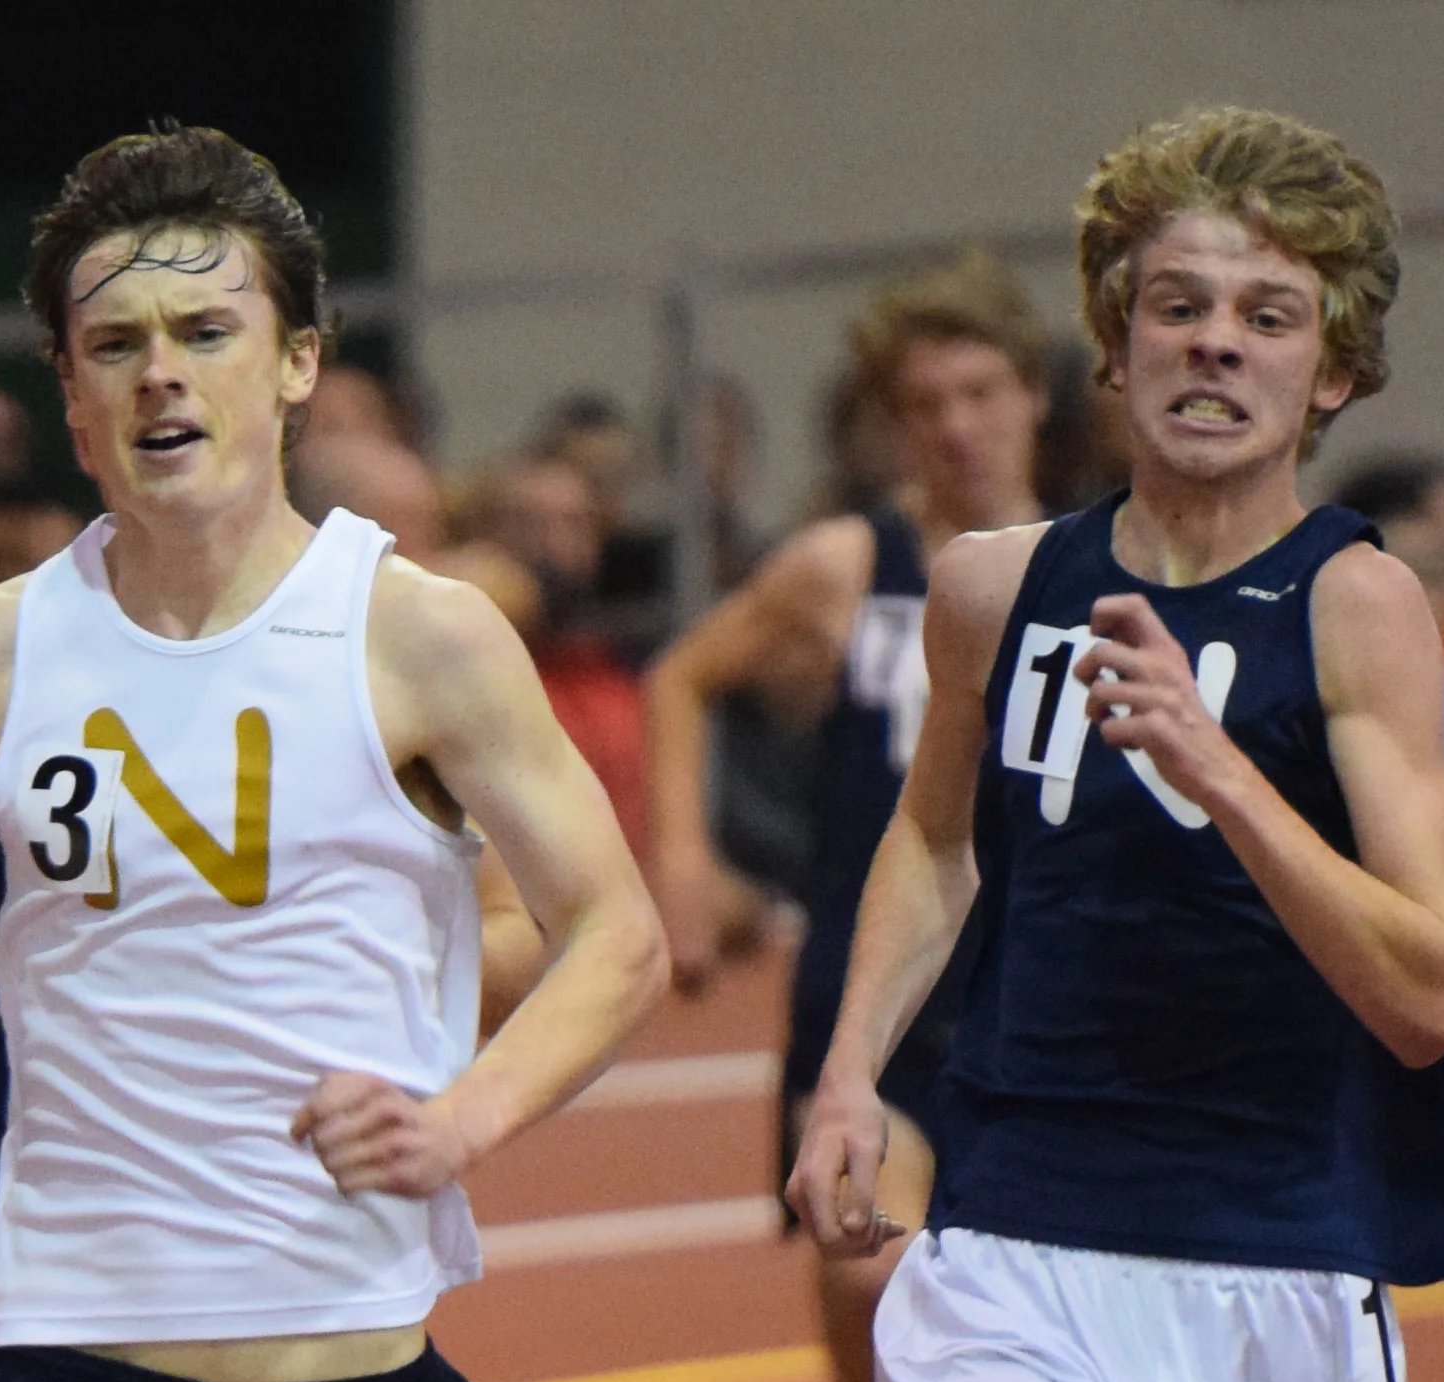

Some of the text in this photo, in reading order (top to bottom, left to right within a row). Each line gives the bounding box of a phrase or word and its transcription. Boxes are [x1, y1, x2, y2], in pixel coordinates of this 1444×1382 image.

[1029, 640, 1075, 764] 1
[29, 754, 98, 882] 3
[83, 707, 271, 910] N
